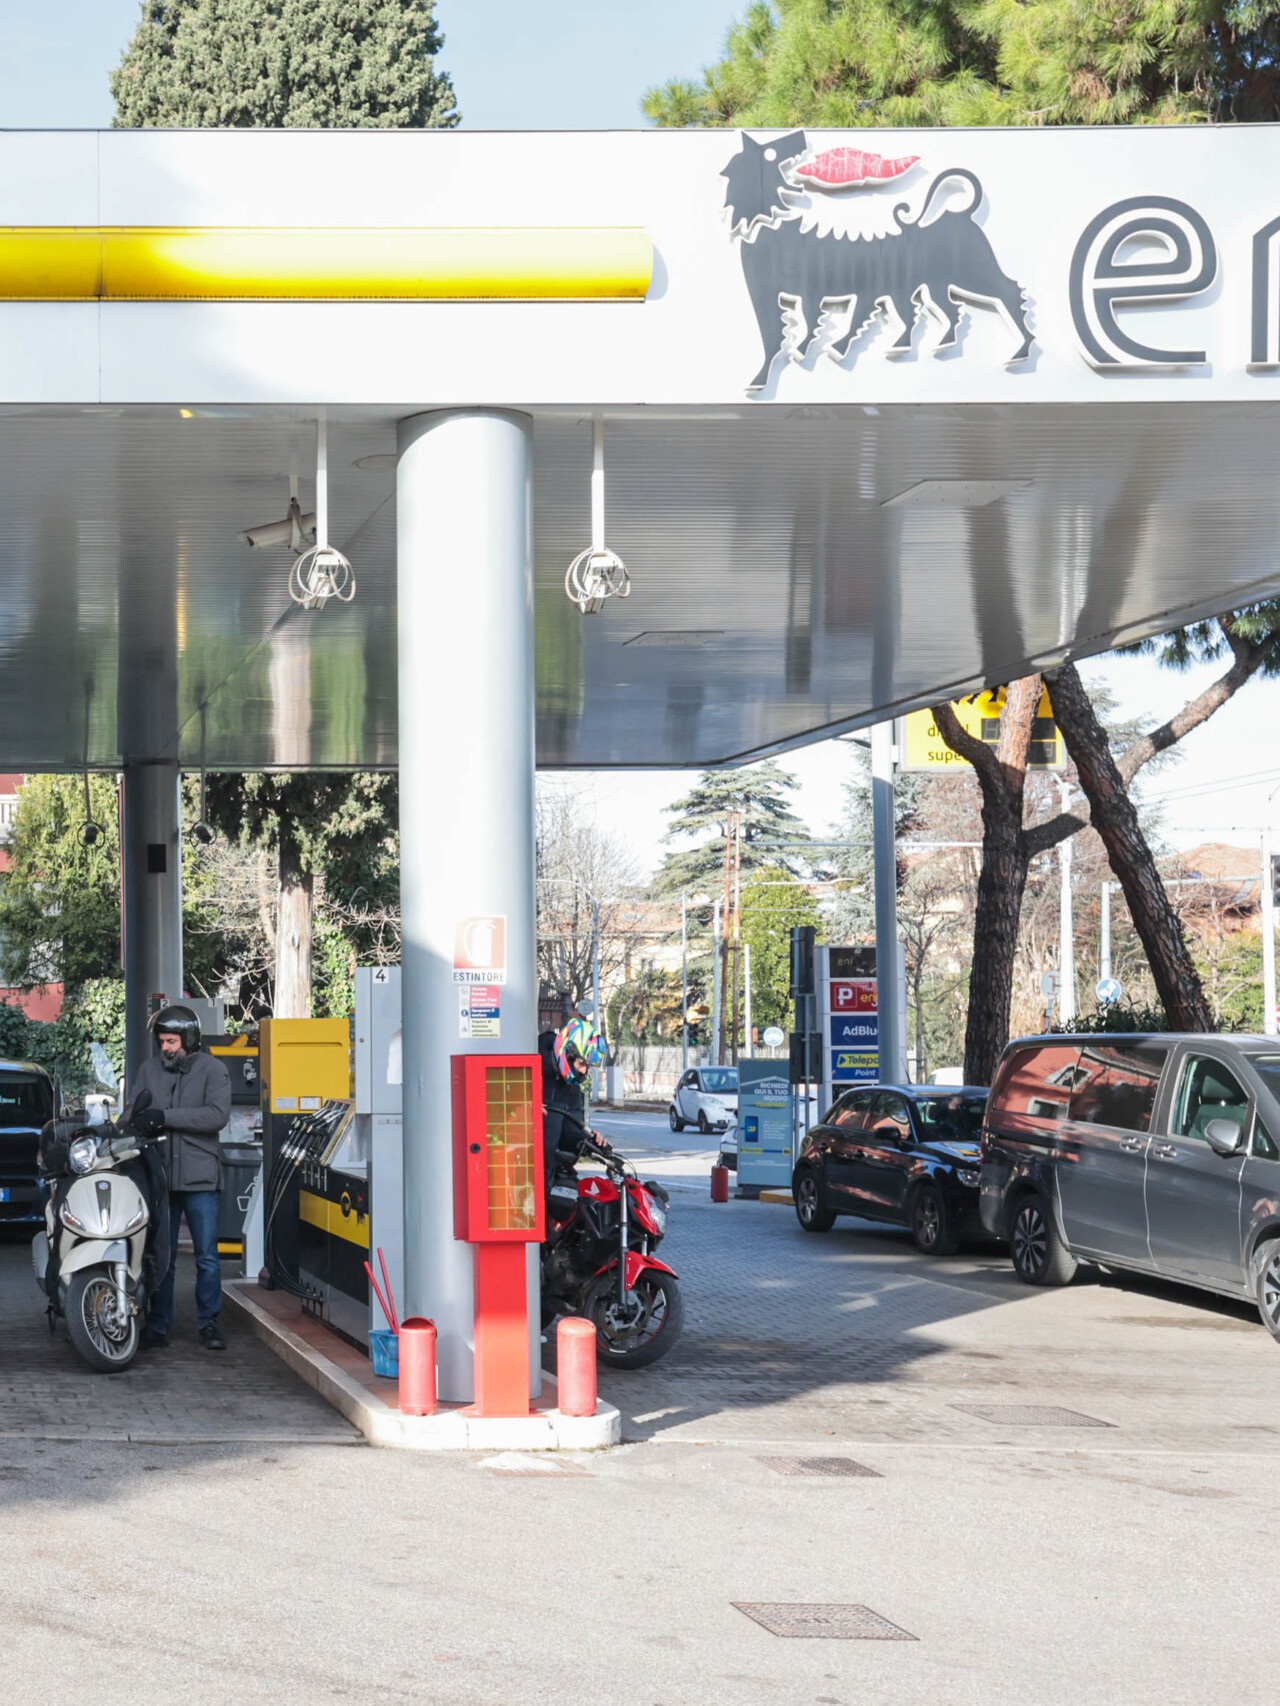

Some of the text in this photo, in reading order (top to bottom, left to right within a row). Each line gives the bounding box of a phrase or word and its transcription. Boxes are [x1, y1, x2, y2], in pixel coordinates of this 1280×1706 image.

[837, 956, 853, 966] eni
[375, 968, 386, 982] 4
[453, 971, 504, 982] ESTINTORE
[162, 999, 169, 1008] 2
[855, 1069, 876, 1077] Point
